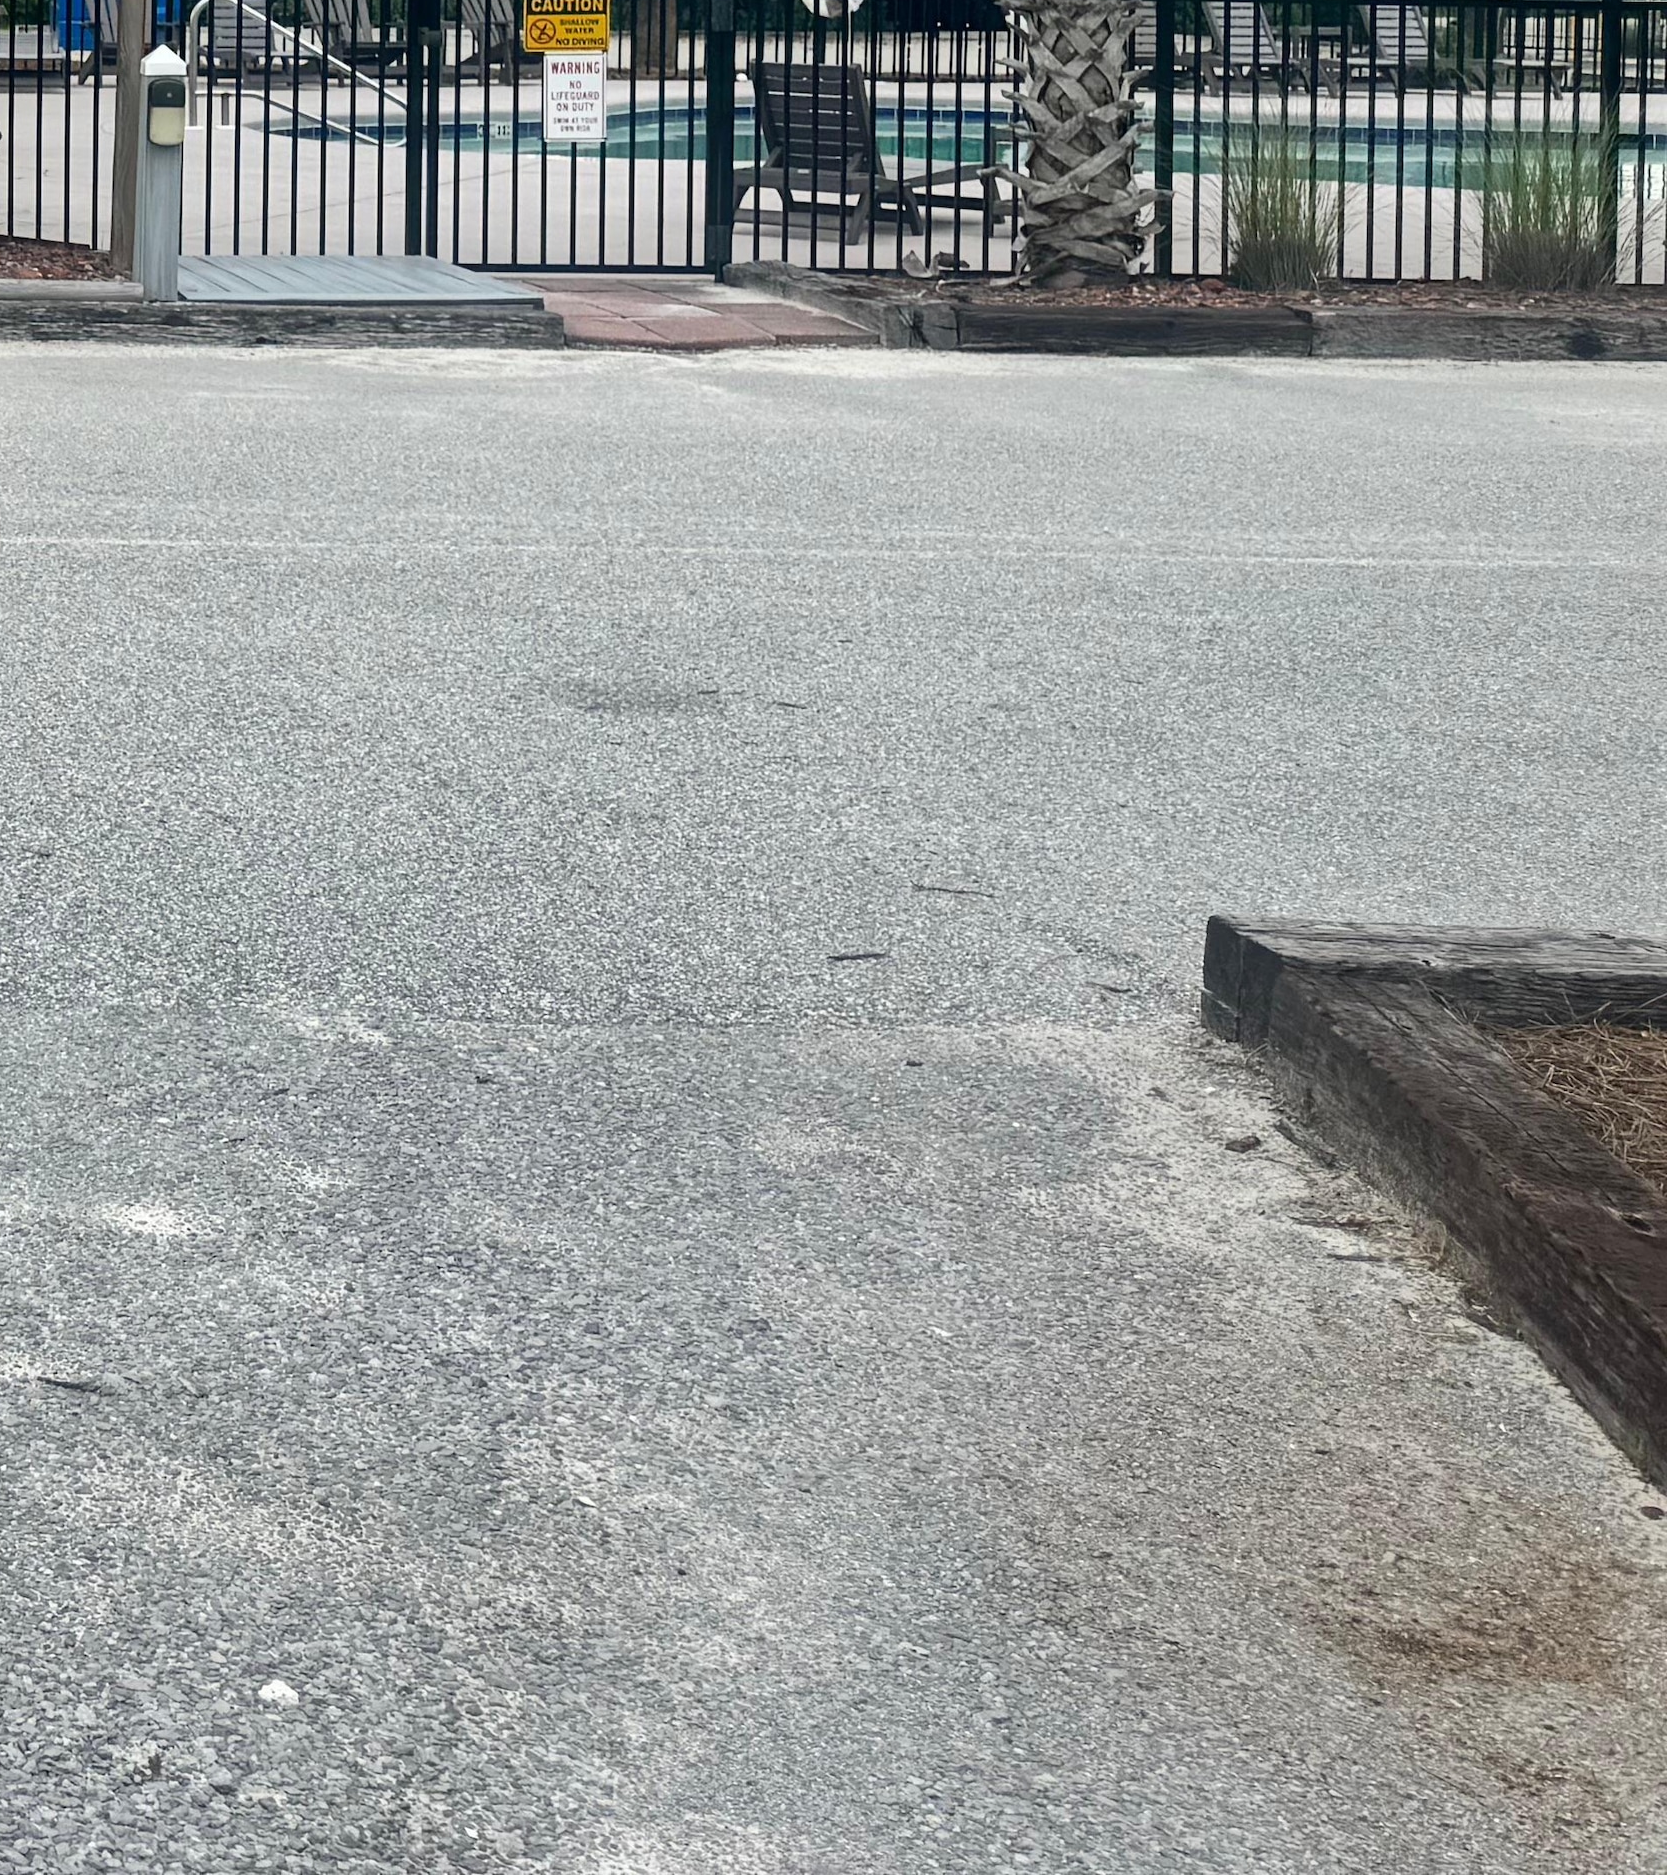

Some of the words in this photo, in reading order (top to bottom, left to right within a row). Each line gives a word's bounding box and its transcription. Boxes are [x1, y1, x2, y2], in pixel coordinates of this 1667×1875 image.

[559, 18, 600, 26] SHALLOW
[555, 37, 570, 46] NO
[572, 37, 604, 46] DIVING
[551, 61, 600, 75] WARNING
[569, 80, 582, 89] NO
[550, 91, 600, 101] LIFEGUARD
[556, 102, 569, 112] ON
[572, 102, 595, 112] DUTY
